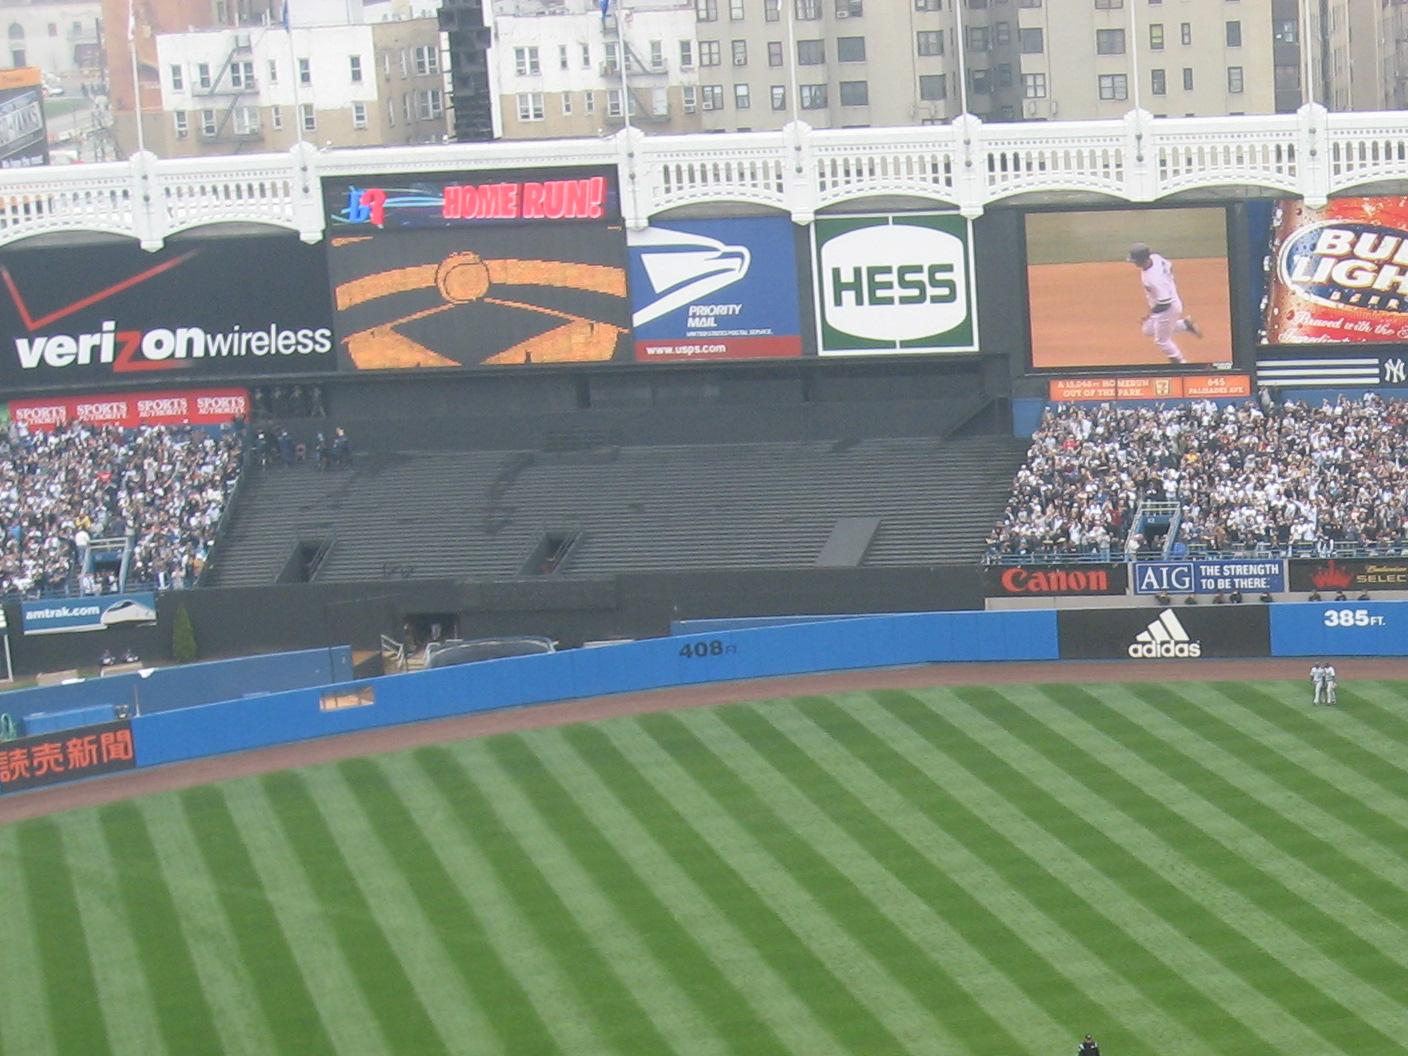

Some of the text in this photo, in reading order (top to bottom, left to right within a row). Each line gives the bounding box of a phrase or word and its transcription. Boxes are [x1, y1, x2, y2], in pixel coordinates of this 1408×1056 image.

[443, 177, 607, 219] HOME RUN!
[832, 263, 957, 308] HESS
[688, 304, 742, 316] PRIORITY
[686, 317, 718, 328] MAIL
[645, 344, 727, 356] www.usps.com
[1062, 388, 1082, 398] OUT
[1083, 388, 1096, 397] OF
[1098, 388, 1116, 397] THE
[77, 401, 128, 416] SPORTS
[137, 398, 188, 411] SPORTS
[197, 396, 245, 410] SPORTS
[16, 405, 66, 420] SPORTS
[1200, 564, 1279, 576] THE STRENGTH
[1001, 564, 1108, 592] Canon
[1140, 566, 1191, 590] AIG
[1201, 579, 1214, 590] TO
[1217, 578, 1231, 589] BE
[26, 606, 100, 620] amtrak.com
[1323, 609, 1369, 627] 385
[679, 640, 723, 658] 408
[1128, 638, 1200, 658] adidas
